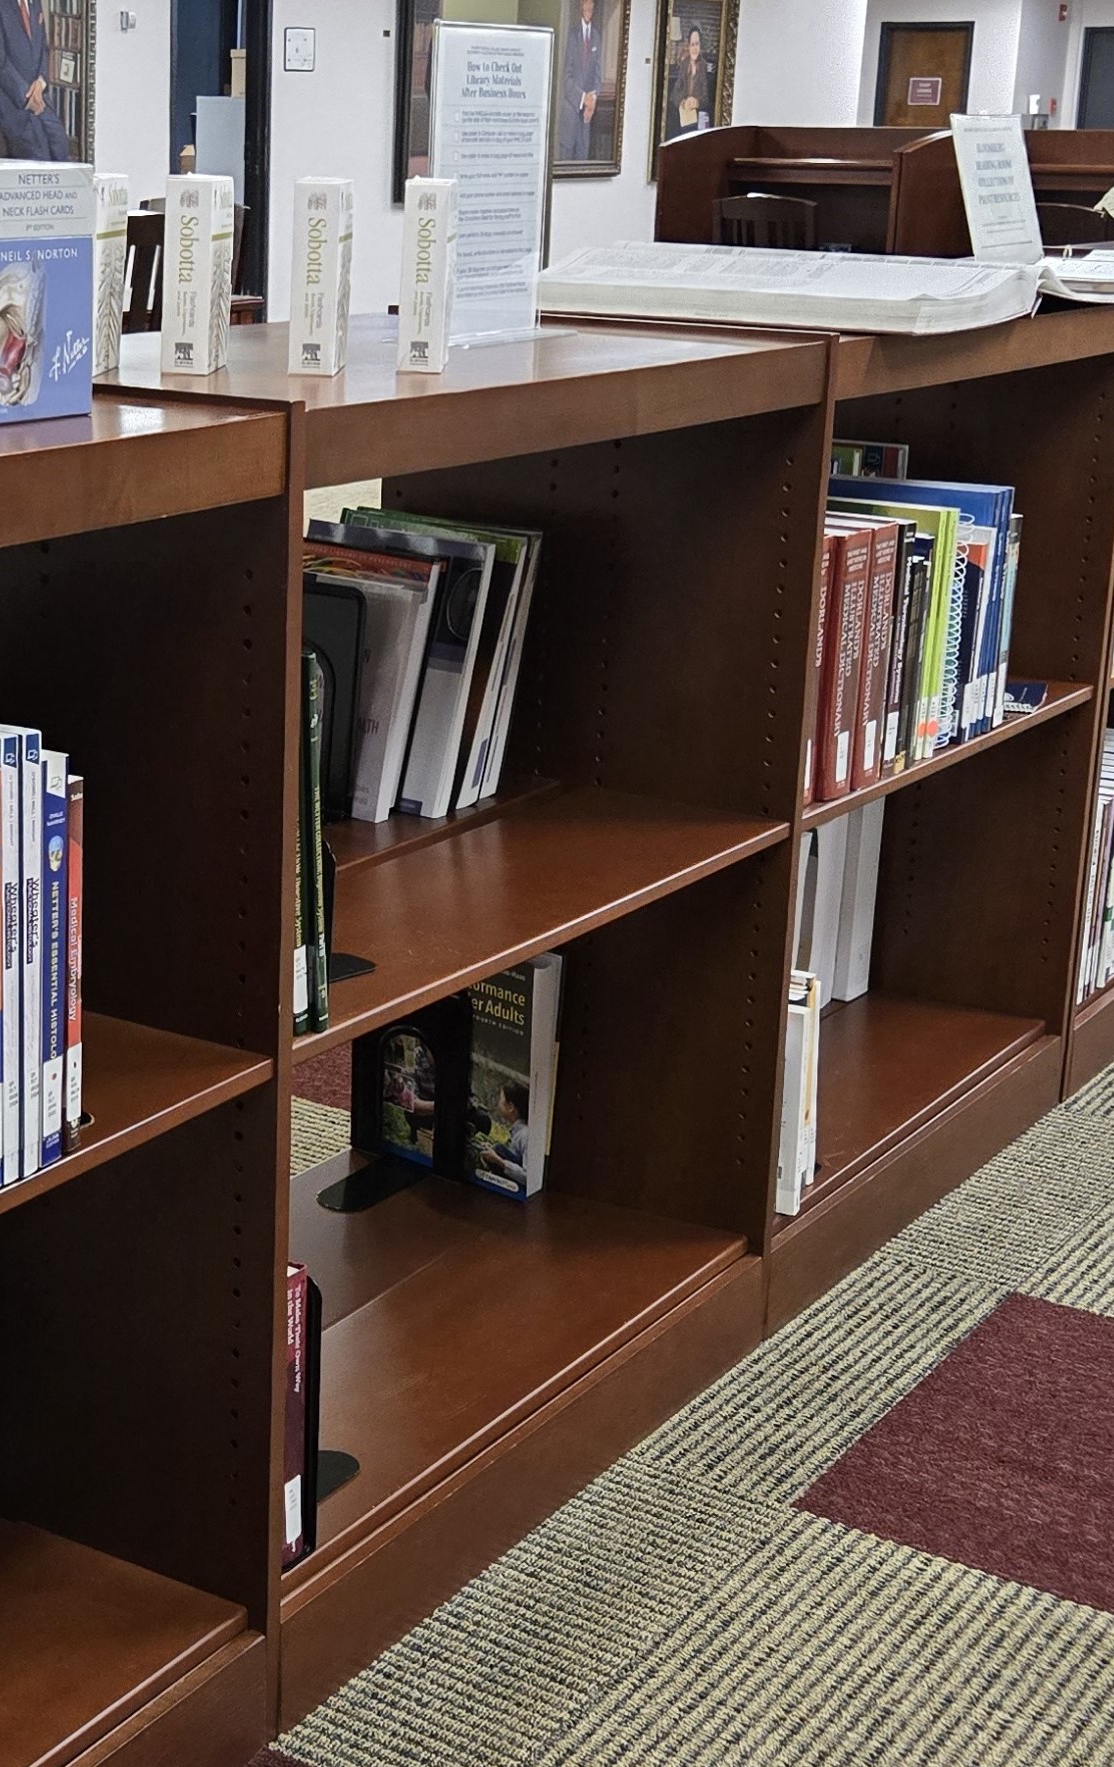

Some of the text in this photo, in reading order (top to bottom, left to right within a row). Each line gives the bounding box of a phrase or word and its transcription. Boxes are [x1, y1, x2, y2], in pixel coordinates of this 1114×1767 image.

[466, 74, 522, 87] Library Materials
[478, 87, 506, 98] Business
[18, 173, 60, 185] NETTER'S
[41, 190, 64, 200] HEAD
[2, 204, 74, 217] NECK FLASH CARDS
[0, 248, 78, 262] NEIL NORTON
[179, 215, 199, 284] Sobotta
[306, 217, 328, 286] Sobotta
[415, 217, 436, 285] Sobotta
[50, 881, 60, 1007] NETTER'S ESSENTIAL
[68, 897, 78, 1021] Medical Embryology
[485, 1000, 525, 1026] Adults
